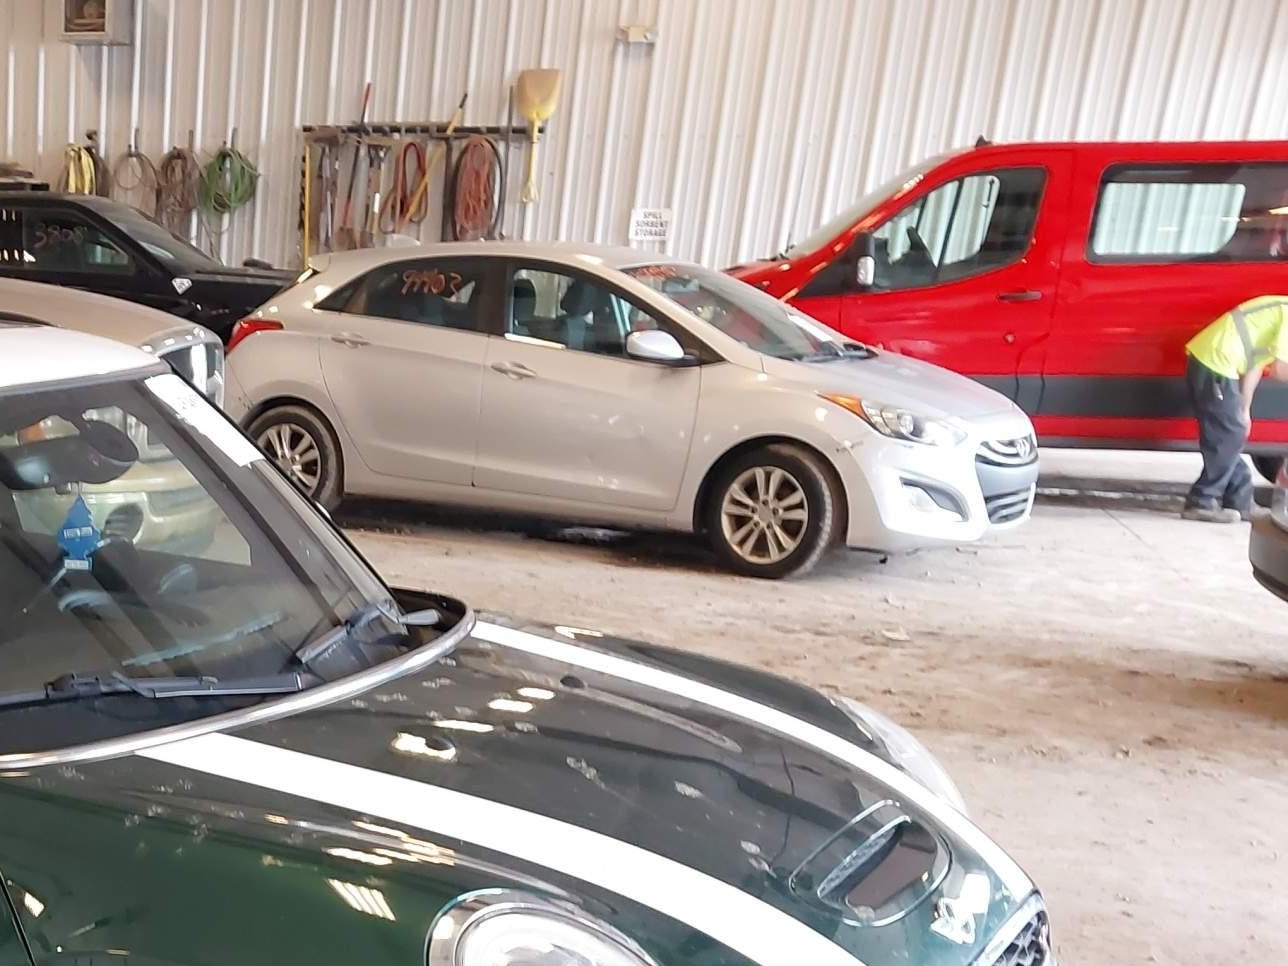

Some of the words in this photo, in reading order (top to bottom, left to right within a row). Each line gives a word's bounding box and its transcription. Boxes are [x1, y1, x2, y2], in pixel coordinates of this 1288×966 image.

[642, 211, 663, 219] SPILL
[635, 220, 669, 228] SORBENT
[634, 229, 666, 237] STORAGE
